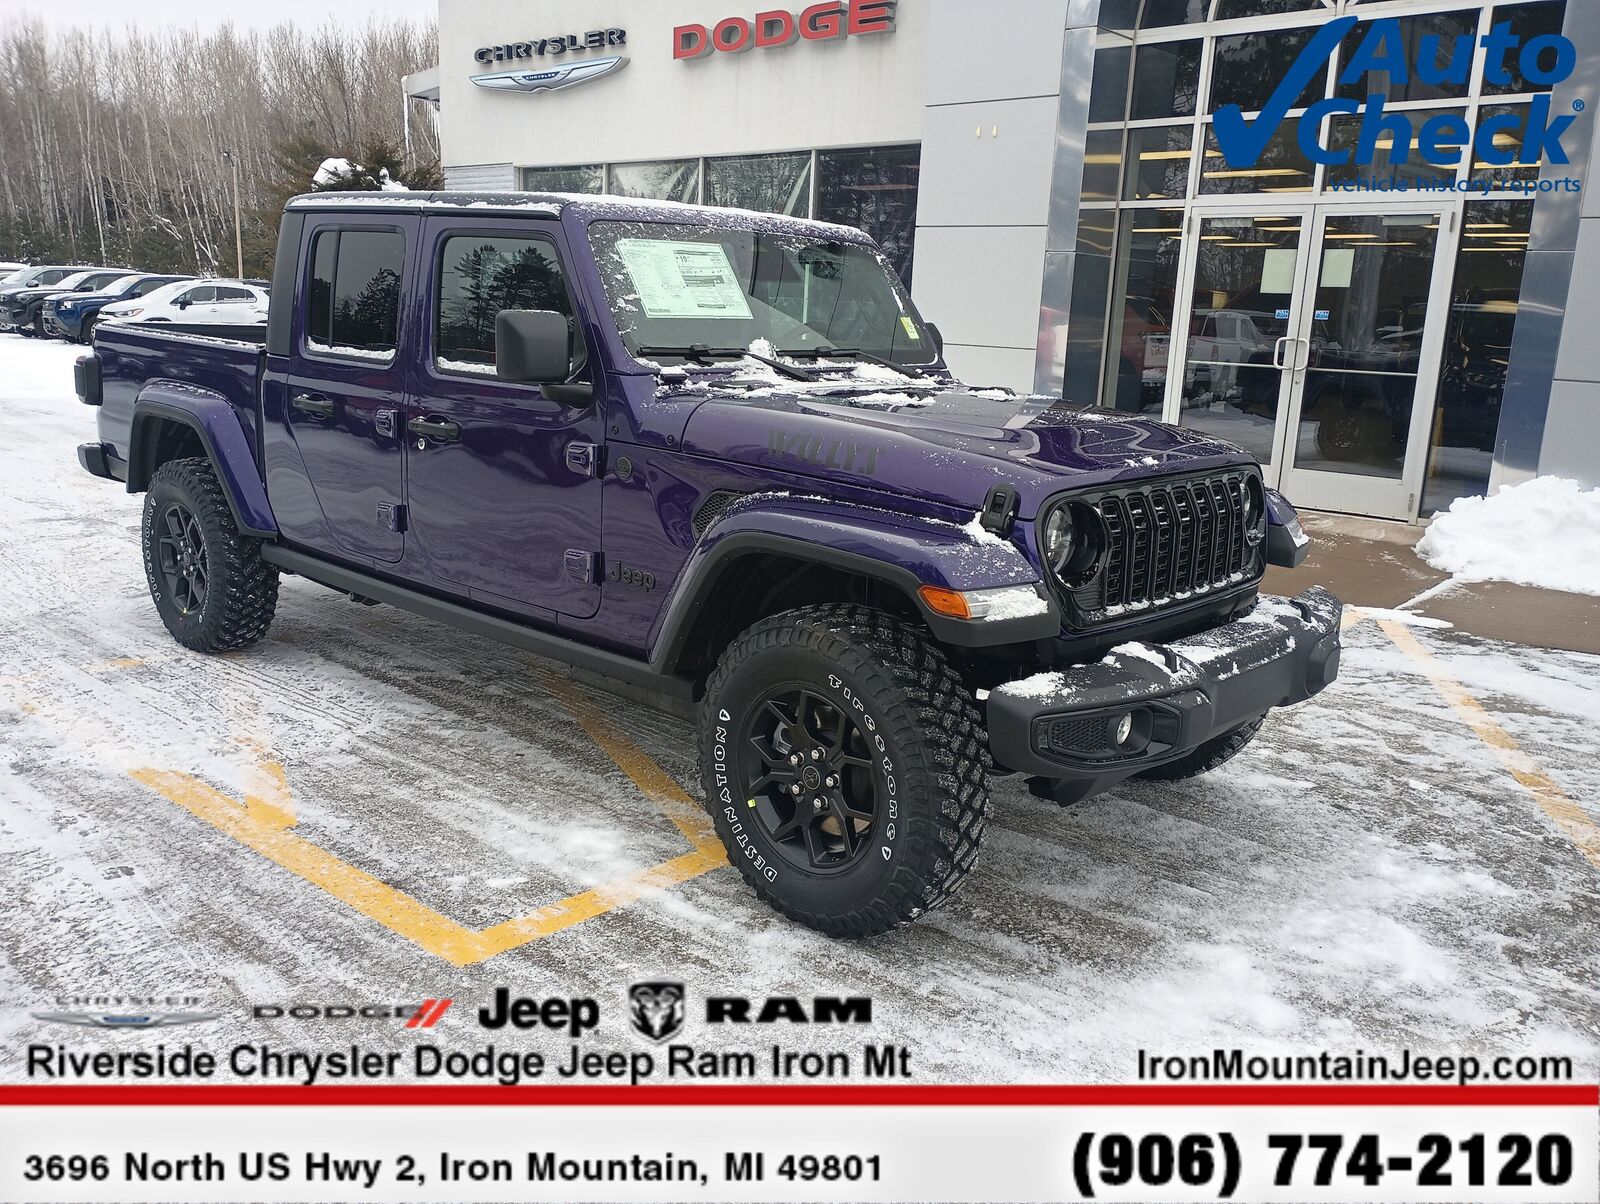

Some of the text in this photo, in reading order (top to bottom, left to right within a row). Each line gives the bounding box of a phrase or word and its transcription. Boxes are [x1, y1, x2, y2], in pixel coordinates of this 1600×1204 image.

[473, 26, 628, 65] CHRYSLER
[672, 0, 896, 61] DODGE
[608, 560, 656, 592] Jeep
[713, 726, 778, 882] DESTINATION
